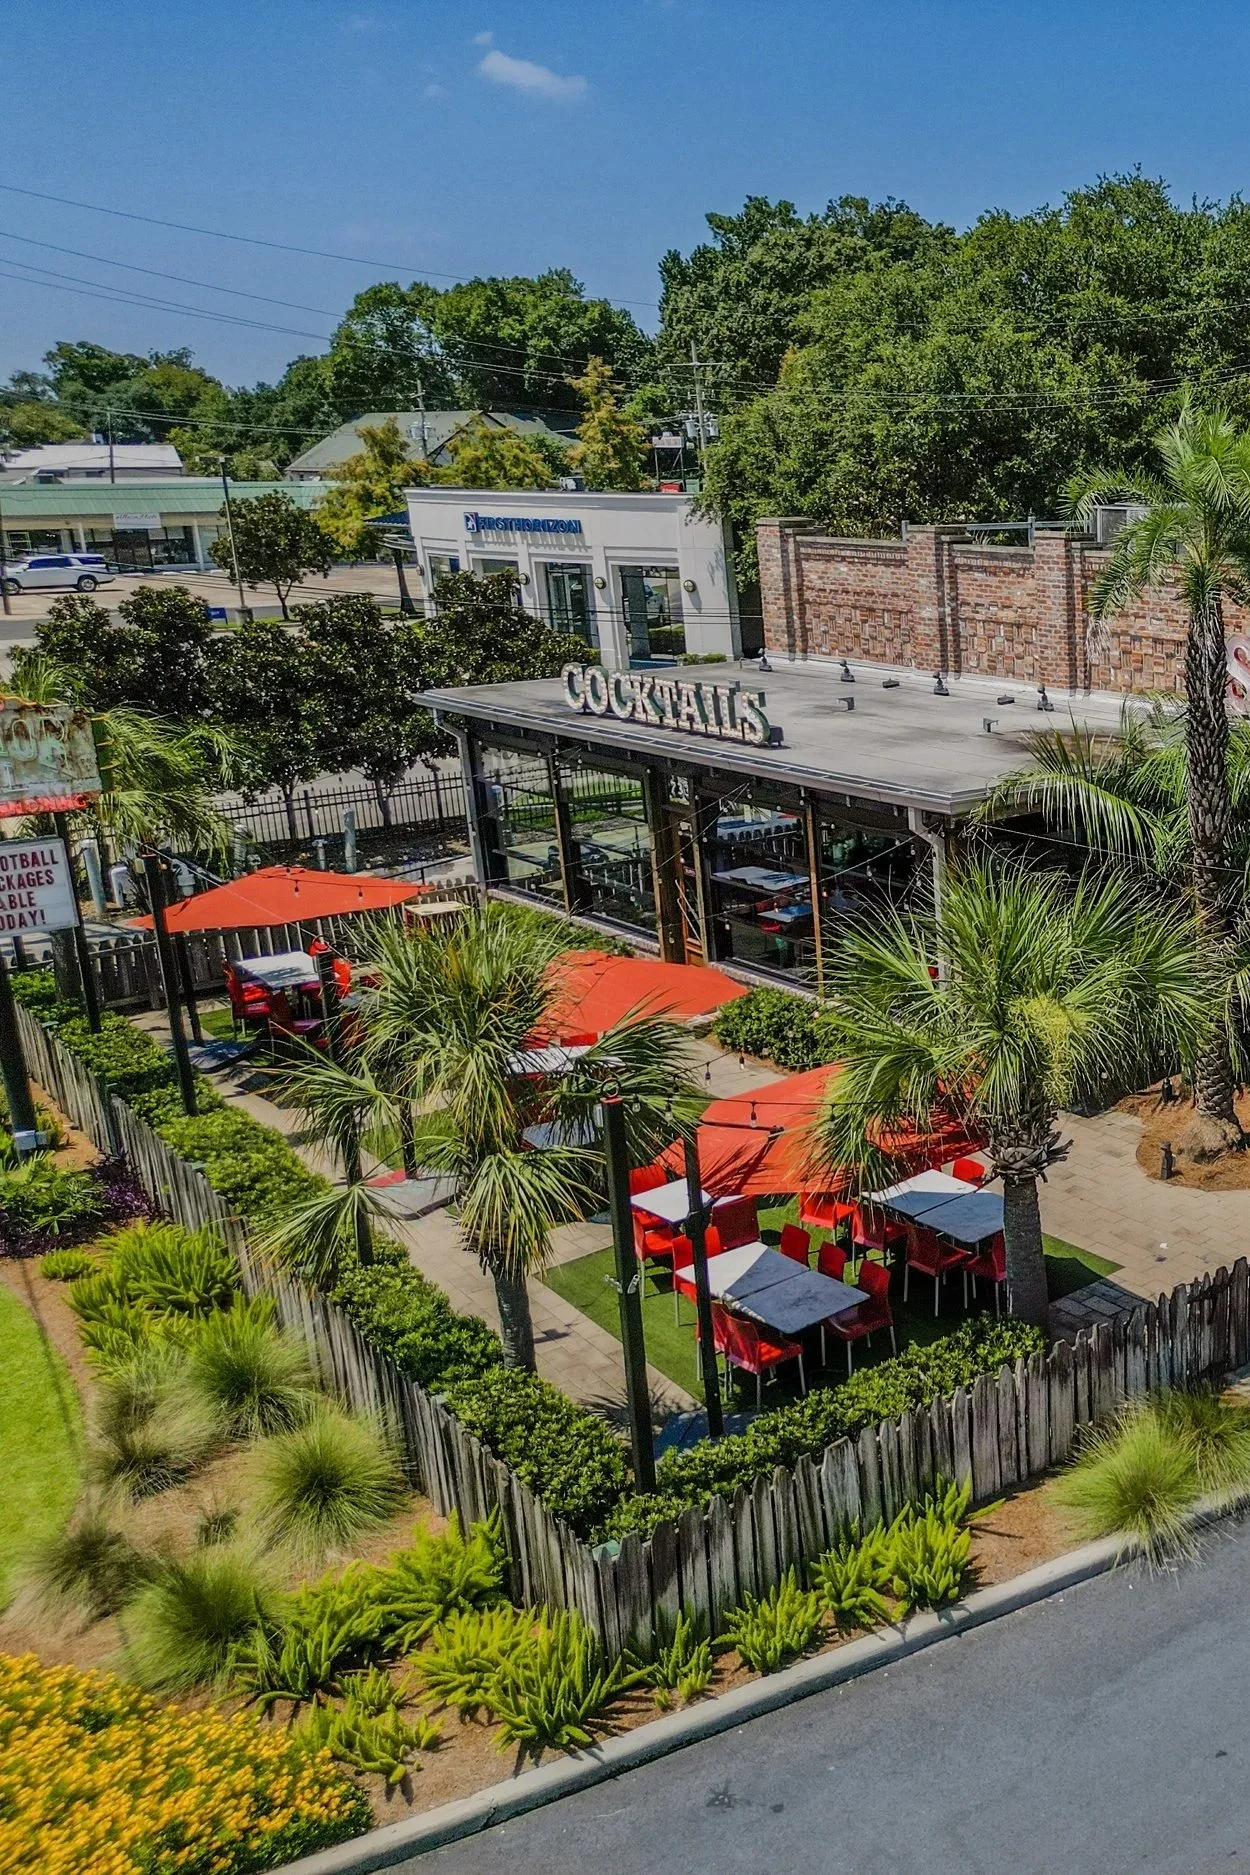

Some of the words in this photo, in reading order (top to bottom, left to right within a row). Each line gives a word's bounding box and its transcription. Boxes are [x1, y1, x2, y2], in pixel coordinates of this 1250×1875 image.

[561, 661, 772, 745] COCKTAILS
[0, 849, 59, 872] OTBALL
[0, 869, 55, 892] CKAGES
